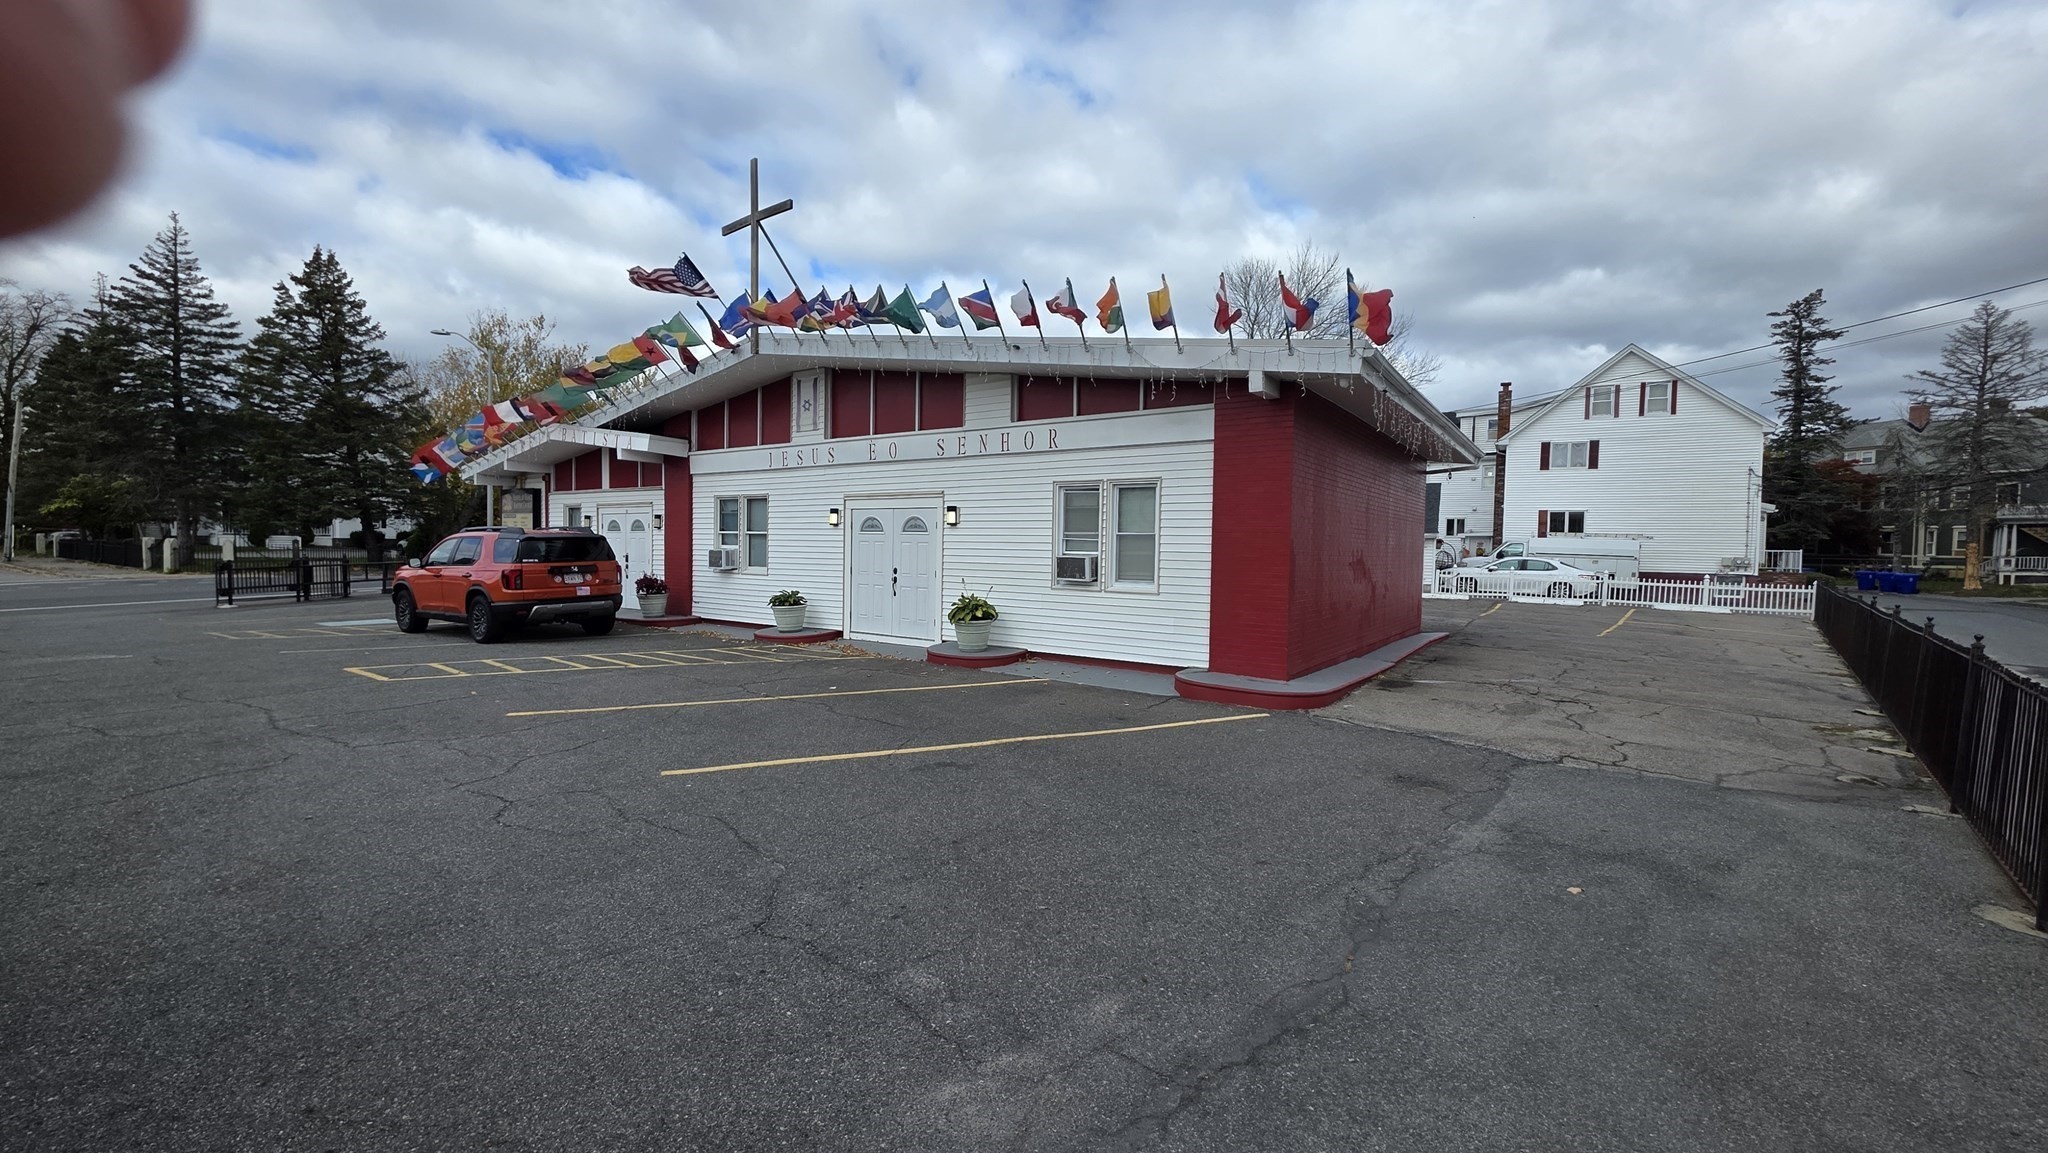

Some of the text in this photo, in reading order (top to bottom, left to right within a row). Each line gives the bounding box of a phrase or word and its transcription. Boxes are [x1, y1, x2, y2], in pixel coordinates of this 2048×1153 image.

[562, 428, 632, 449] BATISTA
[769, 447, 835, 468] JESUS
[936, 428, 1059, 457] SENHOR
